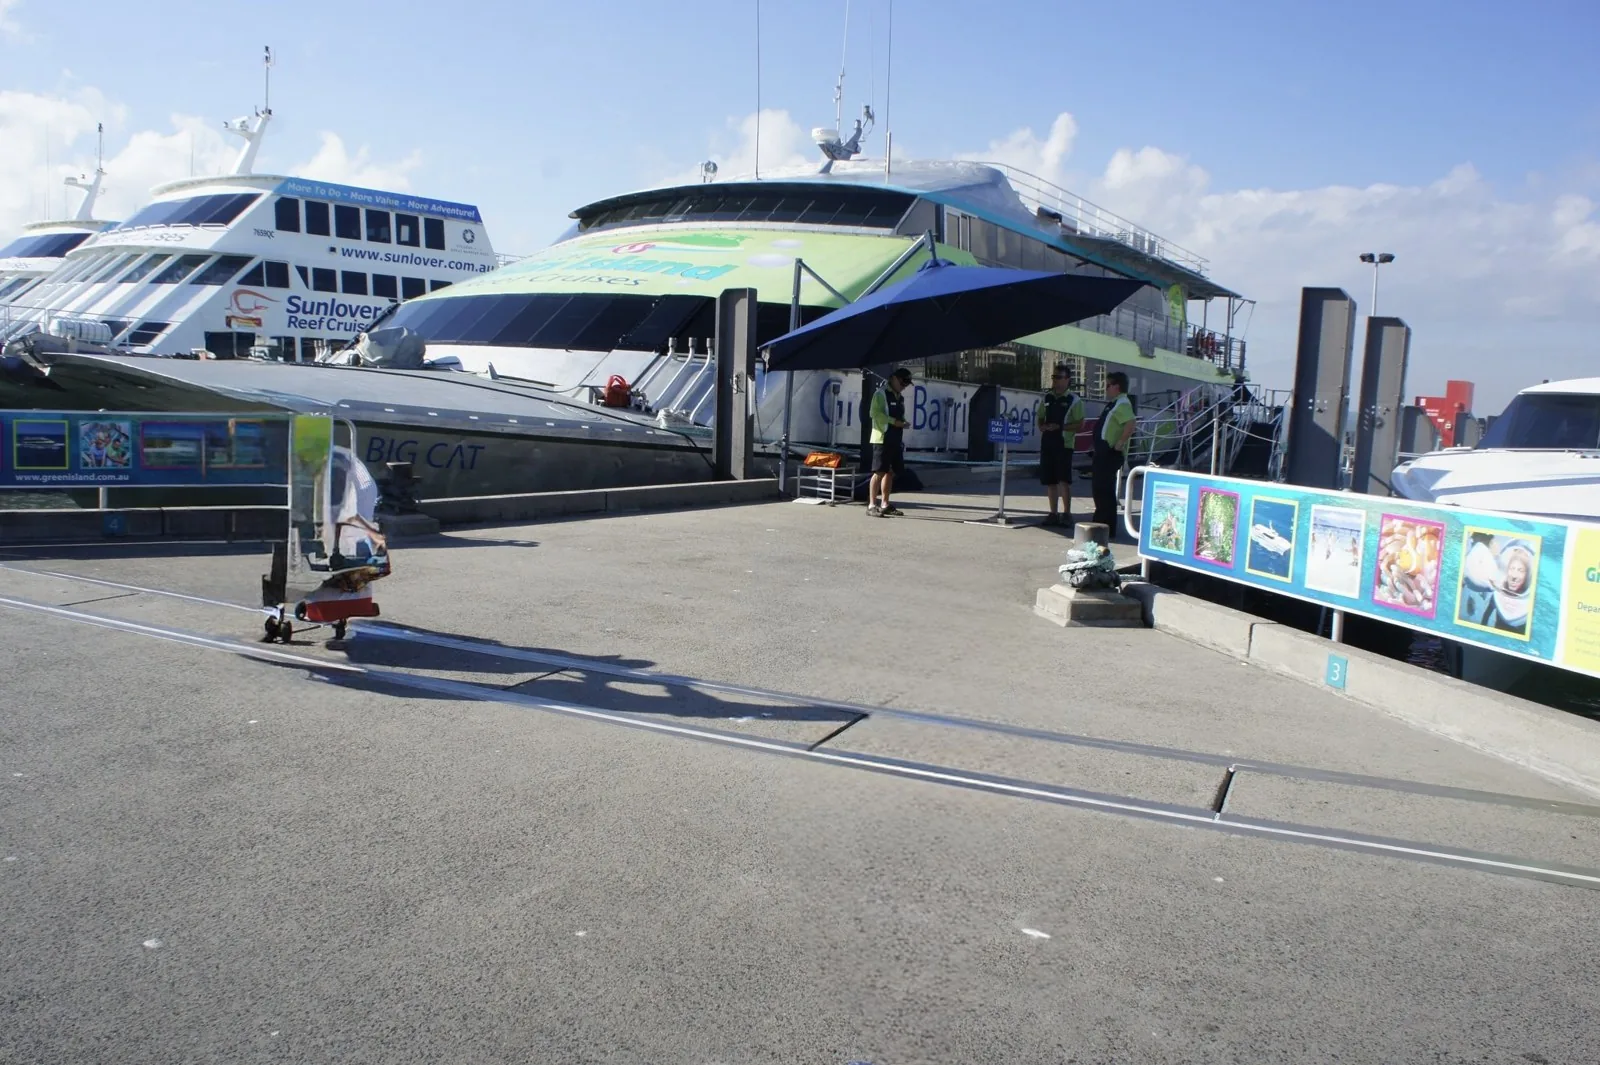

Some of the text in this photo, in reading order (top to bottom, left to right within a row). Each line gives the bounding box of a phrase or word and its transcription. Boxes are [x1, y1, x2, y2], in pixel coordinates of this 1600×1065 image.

[287, 181, 312, 194] More
[314, 186, 326, 195] To
[328, 188, 341, 198] Do
[350, 189, 373, 203] More
[375, 194, 399, 207] Value
[408, 198, 429, 212] More
[430, 202, 476, 218] Adventure!
[341, 247, 495, 273] www.sunlover.com.au
[529, 273, 648, 287] Cruises
[286, 295, 383, 320] Sunlover
[287, 315, 325, 330] Reef
[912, 385, 968, 433] Barri
[366, 436, 485, 470] BIG CAT
[15, 472, 130, 483] www.greenisland.com.au
[108, 518, 119, 529] 4
[1330, 661, 1341, 682] 3
